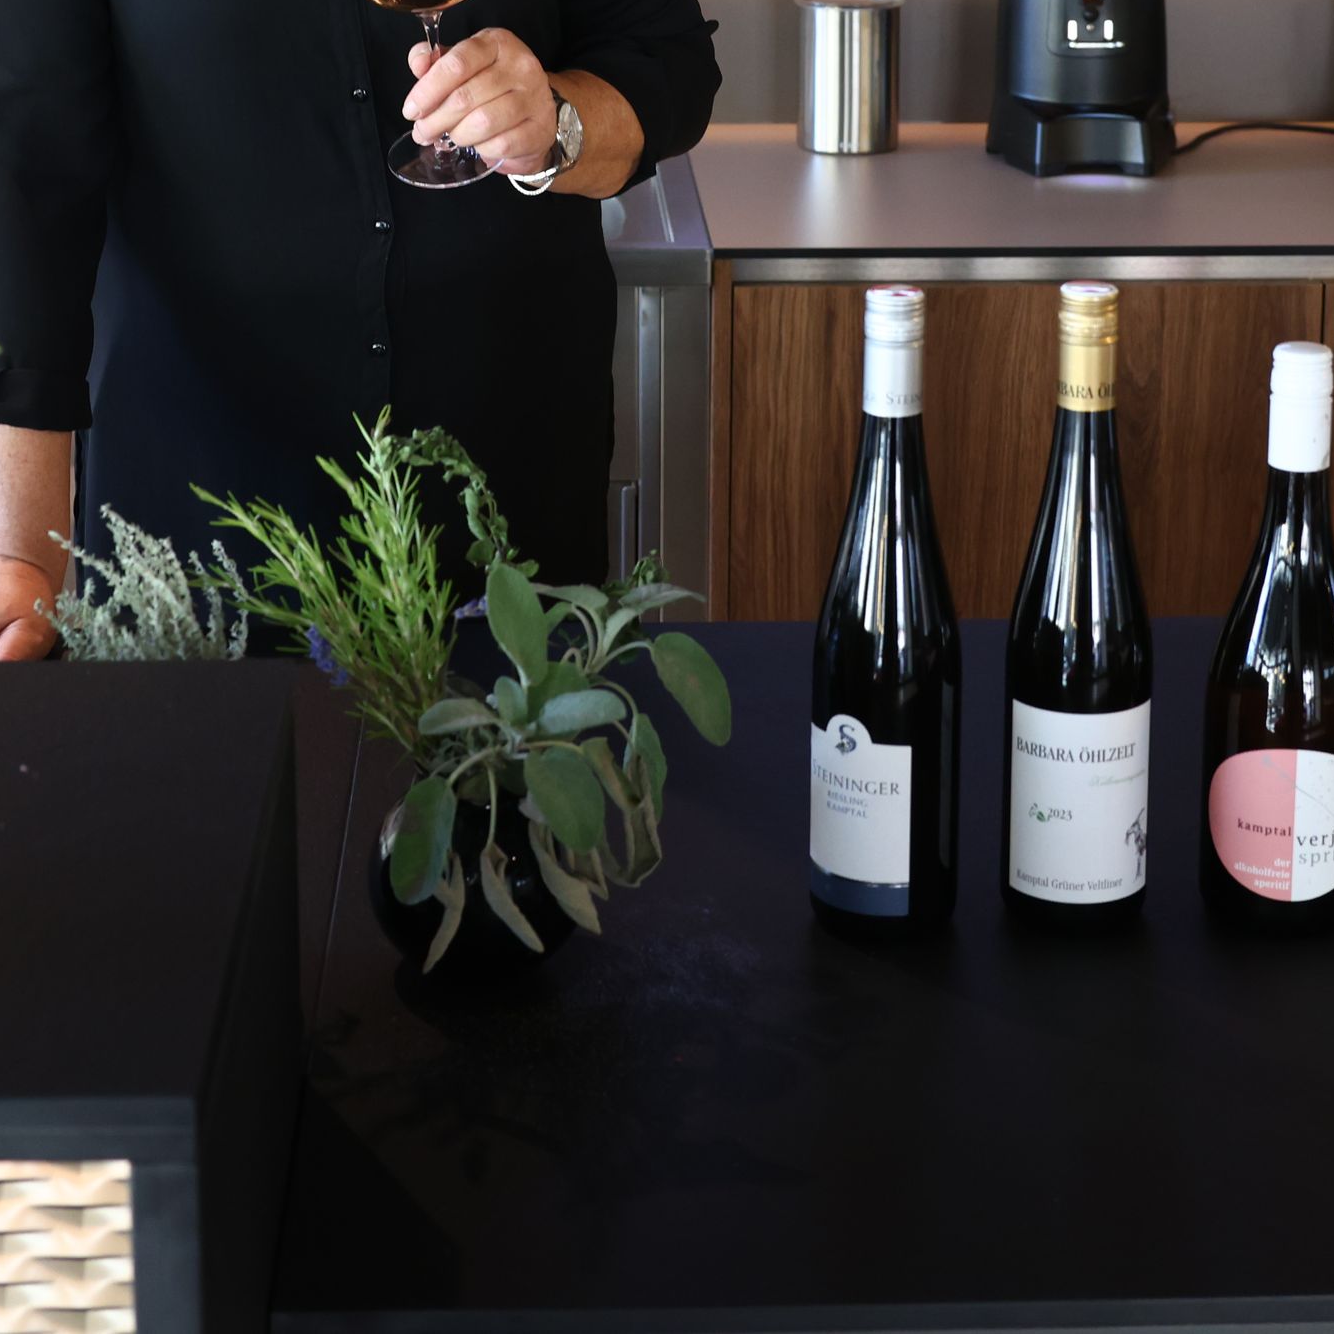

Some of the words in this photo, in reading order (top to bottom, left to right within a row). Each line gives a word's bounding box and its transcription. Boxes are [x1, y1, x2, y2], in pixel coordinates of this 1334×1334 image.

[1016, 735, 1075, 764] BARBARA
[1078, 742, 1137, 764] ÖHLZELT
[812, 758, 901, 796] STEININGER
[1046, 807, 1074, 822] 2023
[1237, 817, 1293, 838] kamptal
[1273, 858, 1291, 868] der
[1051, 877, 1085, 892] Grüner
[1253, 878, 1292, 891] aperitif
